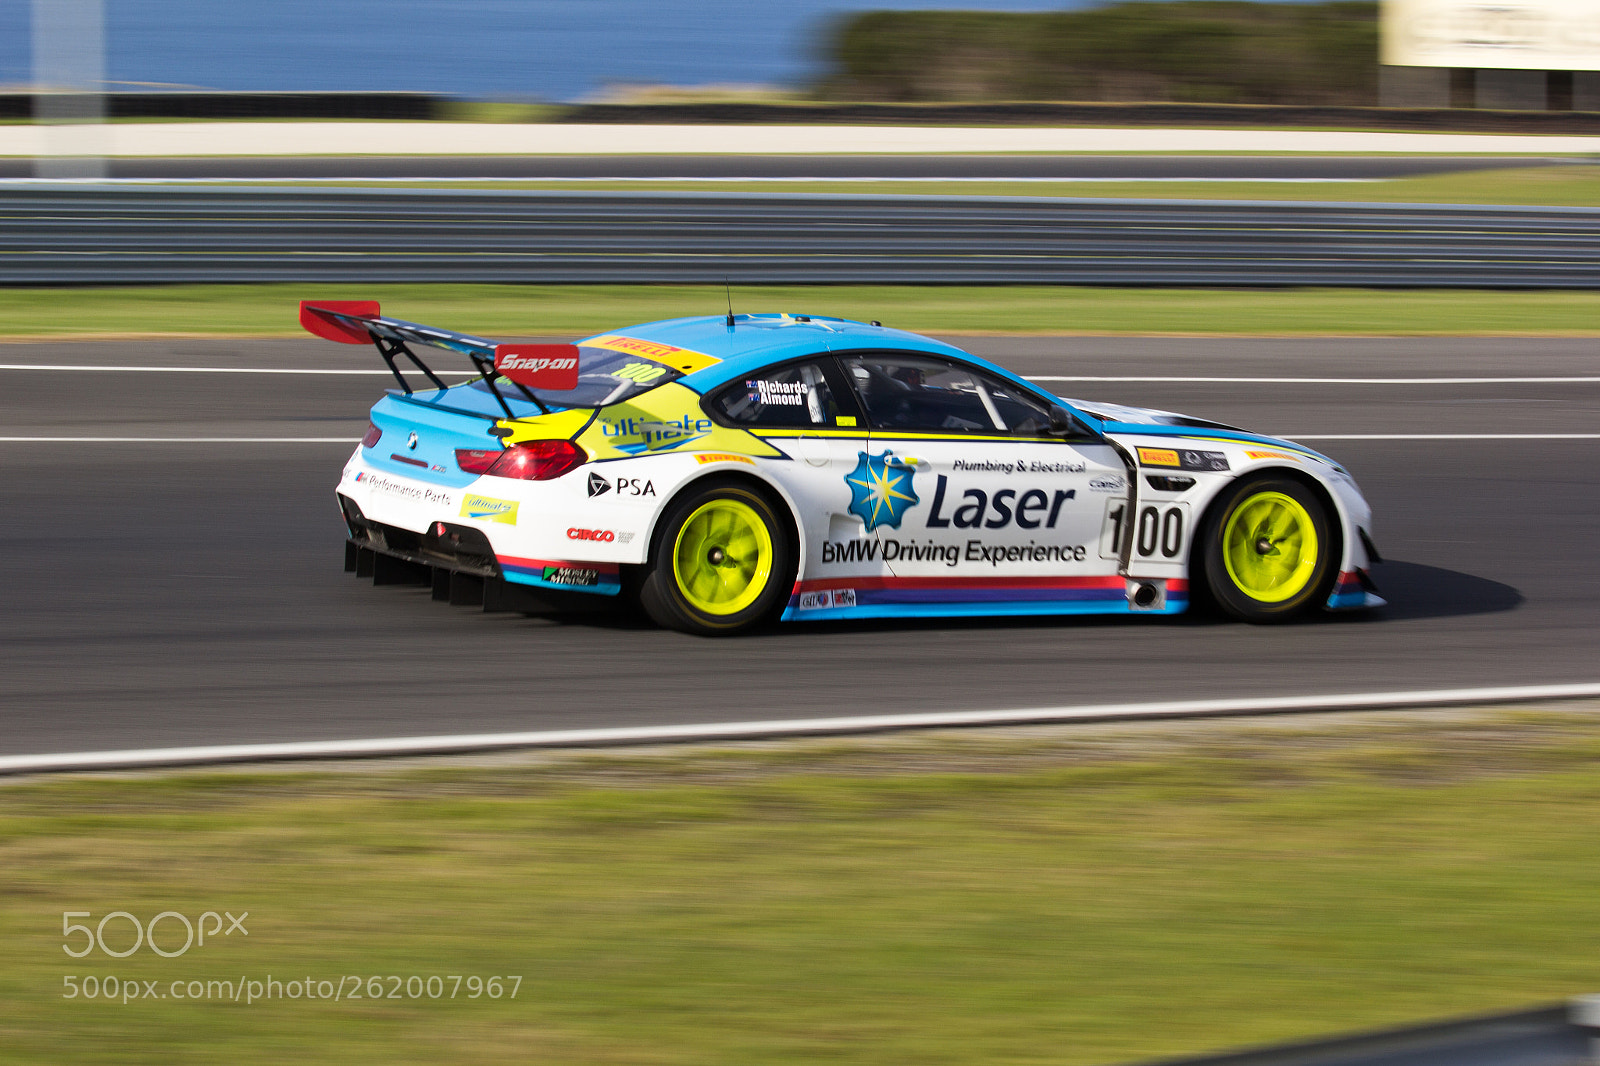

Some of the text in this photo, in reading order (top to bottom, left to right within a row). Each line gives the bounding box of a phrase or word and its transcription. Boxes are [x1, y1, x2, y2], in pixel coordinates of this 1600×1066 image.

[604, 338, 682, 356] PIRELLI
[498, 354, 577, 373] Snap-on
[611, 363, 667, 383] 100
[760, 391, 803, 406] Almond
[953, 460, 1086, 474] Plumbing & Electrical
[369, 475, 422, 499] Performance
[424, 488, 451, 506] Parts
[617, 478, 656, 496] PSA
[926, 474, 1075, 529] Laser
[567, 527, 615, 542] CIRCO
[1109, 504, 1182, 557] 100
[822, 540, 1086, 567] BMW Driving Experience
[549, 574, 590, 586] MINING
